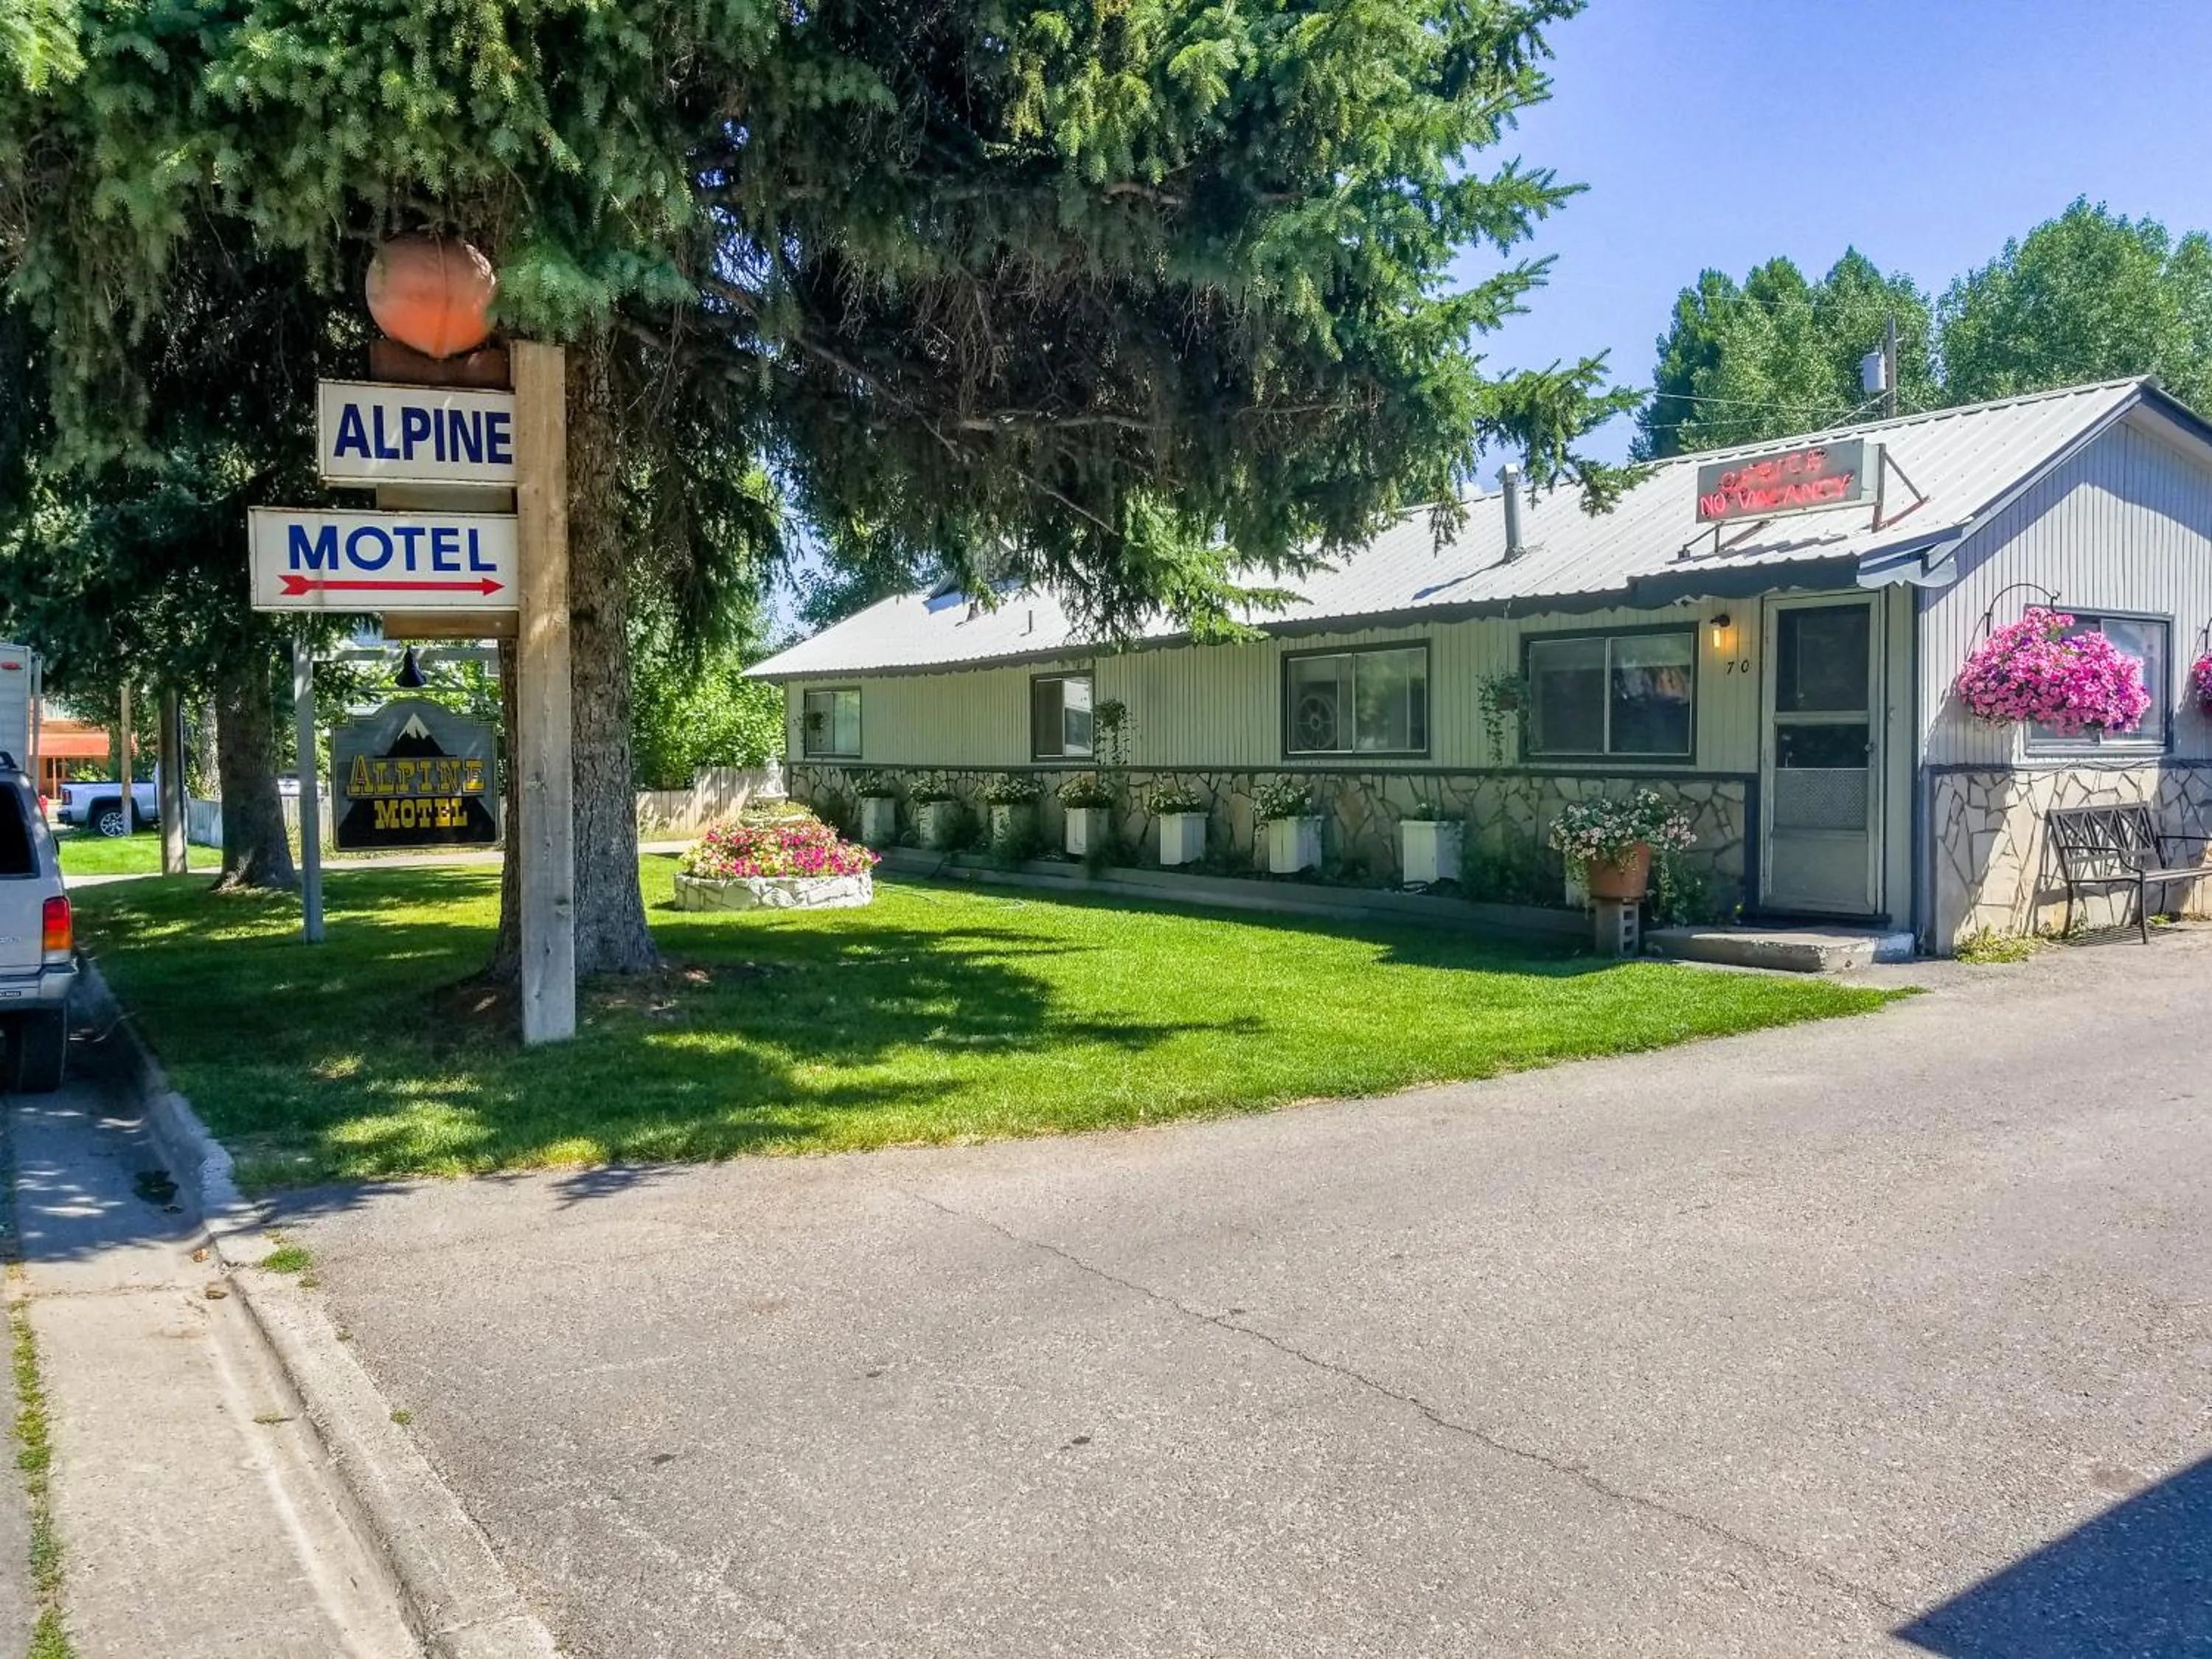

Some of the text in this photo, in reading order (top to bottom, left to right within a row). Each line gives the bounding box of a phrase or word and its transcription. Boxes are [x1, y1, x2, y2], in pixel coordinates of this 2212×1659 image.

[334, 403, 512, 464] ALPINE
[1700, 492, 1728, 517] NO
[288, 524, 497, 571] MOTEL
[1726, 660, 1750, 675] 70
[347, 754, 484, 796] ALPINE
[375, 798, 468, 830] MOTEL
